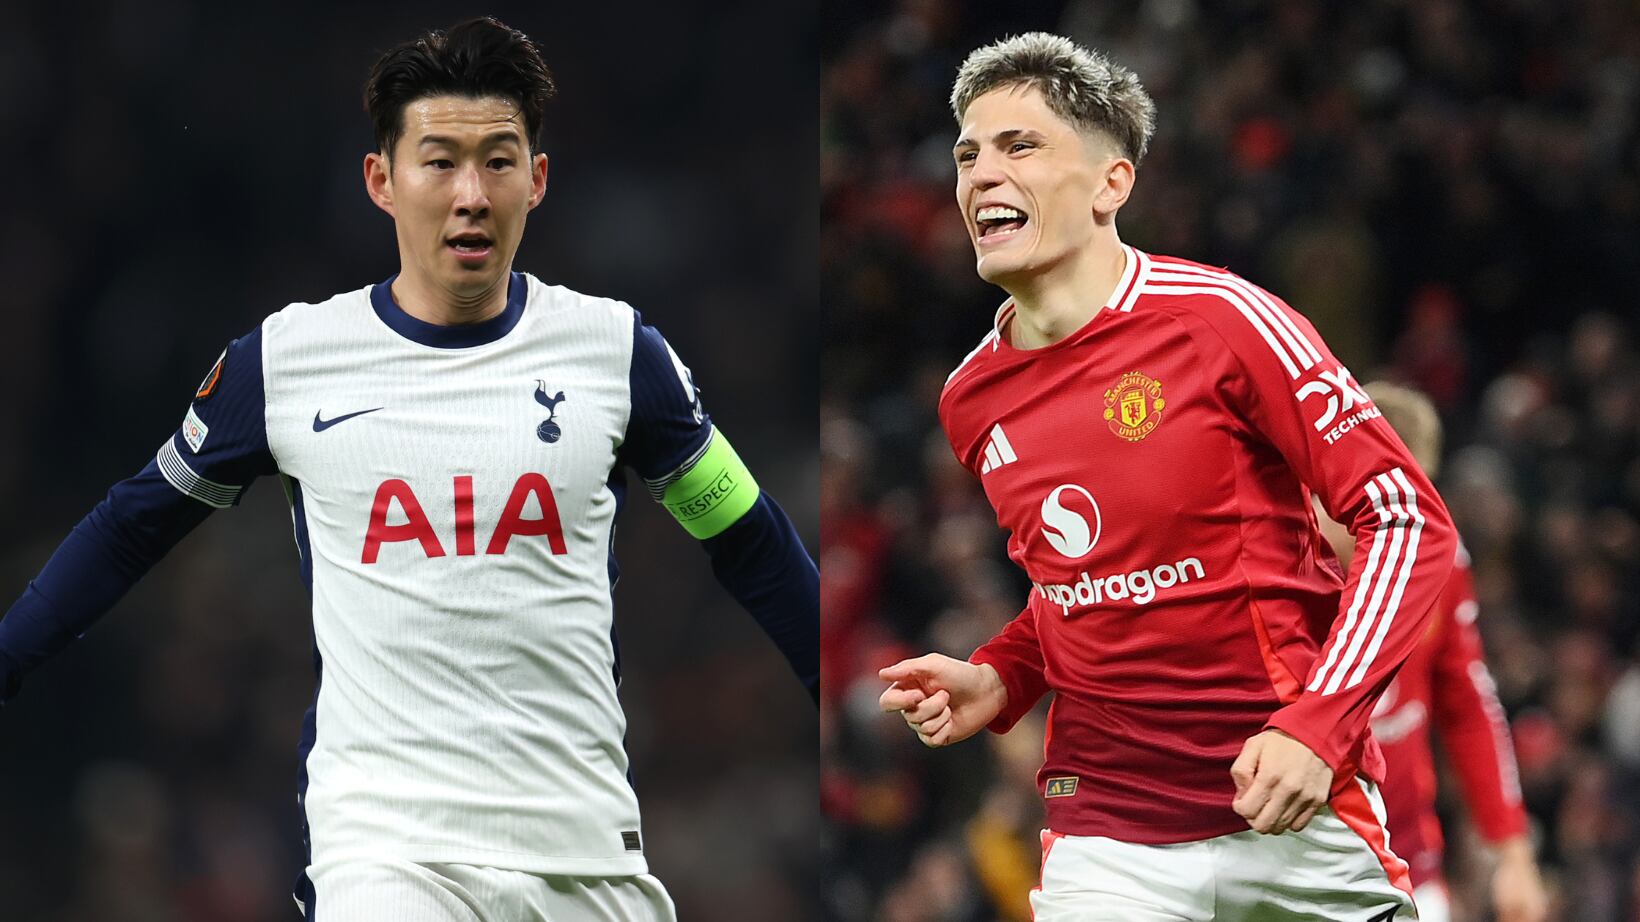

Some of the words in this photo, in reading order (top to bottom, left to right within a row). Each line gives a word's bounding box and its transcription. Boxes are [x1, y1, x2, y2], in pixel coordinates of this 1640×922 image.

[1119, 421, 1154, 437] UNITED
[679, 471, 733, 517] RESPECT
[361, 472, 568, 564] AIA
